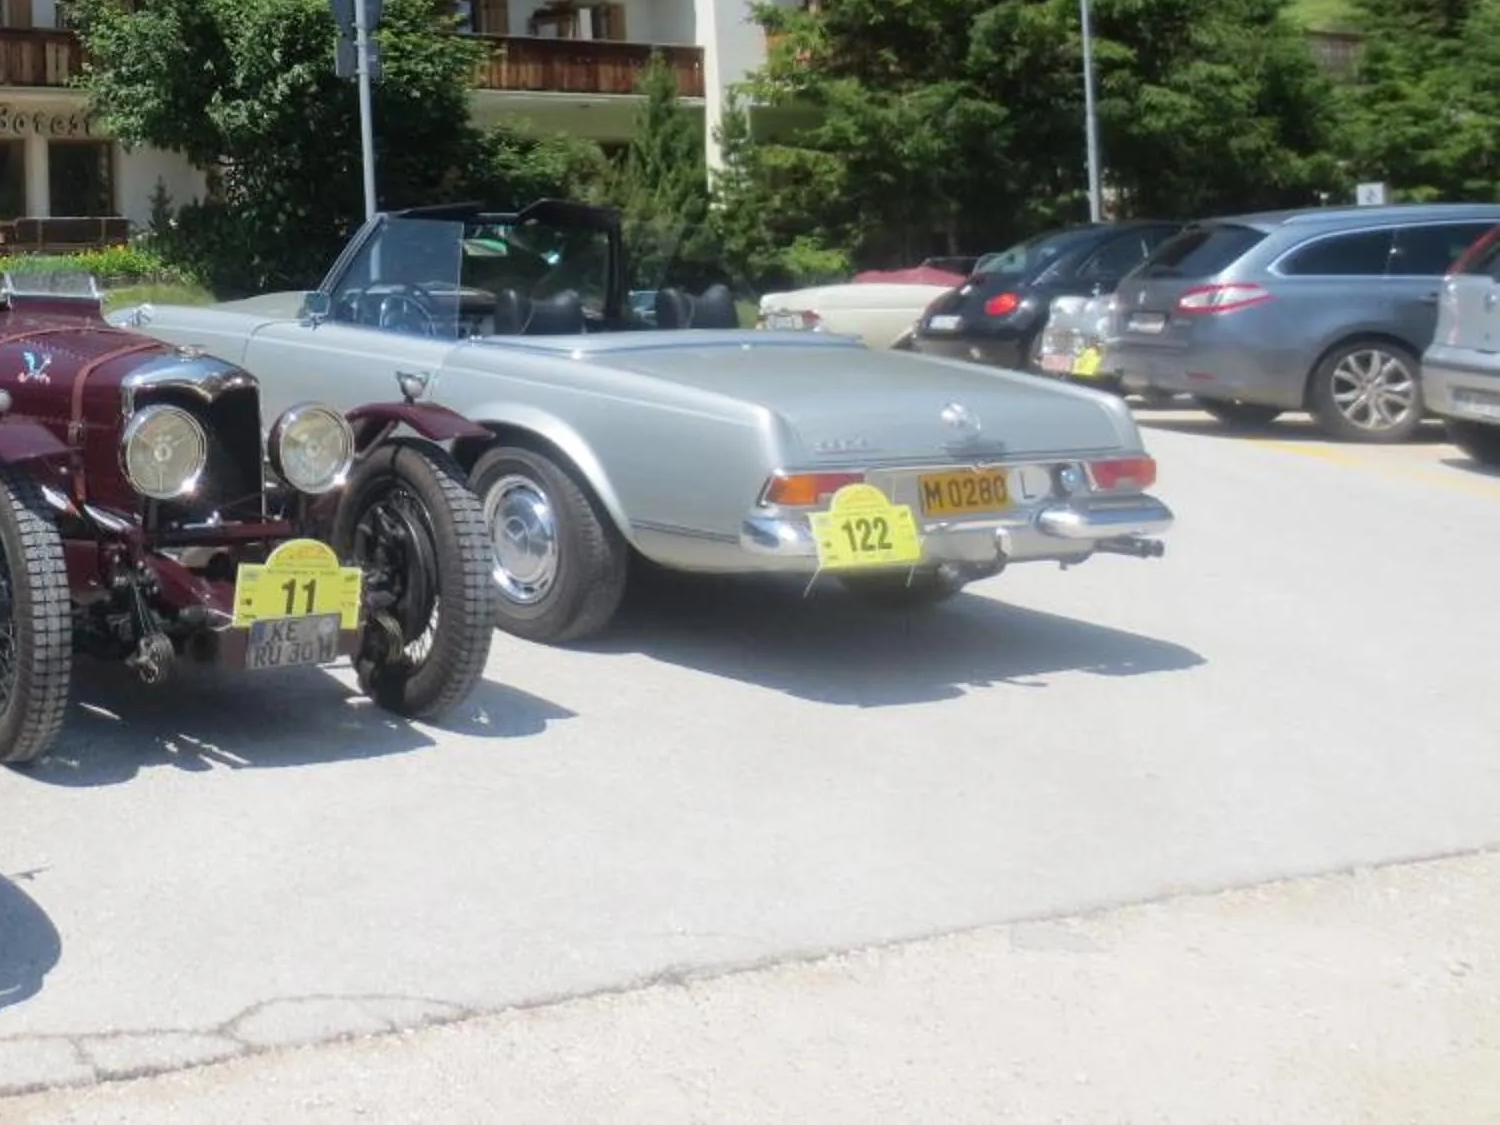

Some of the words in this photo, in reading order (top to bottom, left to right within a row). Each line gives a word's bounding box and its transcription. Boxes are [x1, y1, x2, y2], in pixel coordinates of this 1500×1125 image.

[923, 479, 944, 509] M
[841, 516, 892, 552] 122
[281, 578, 317, 615] 11
